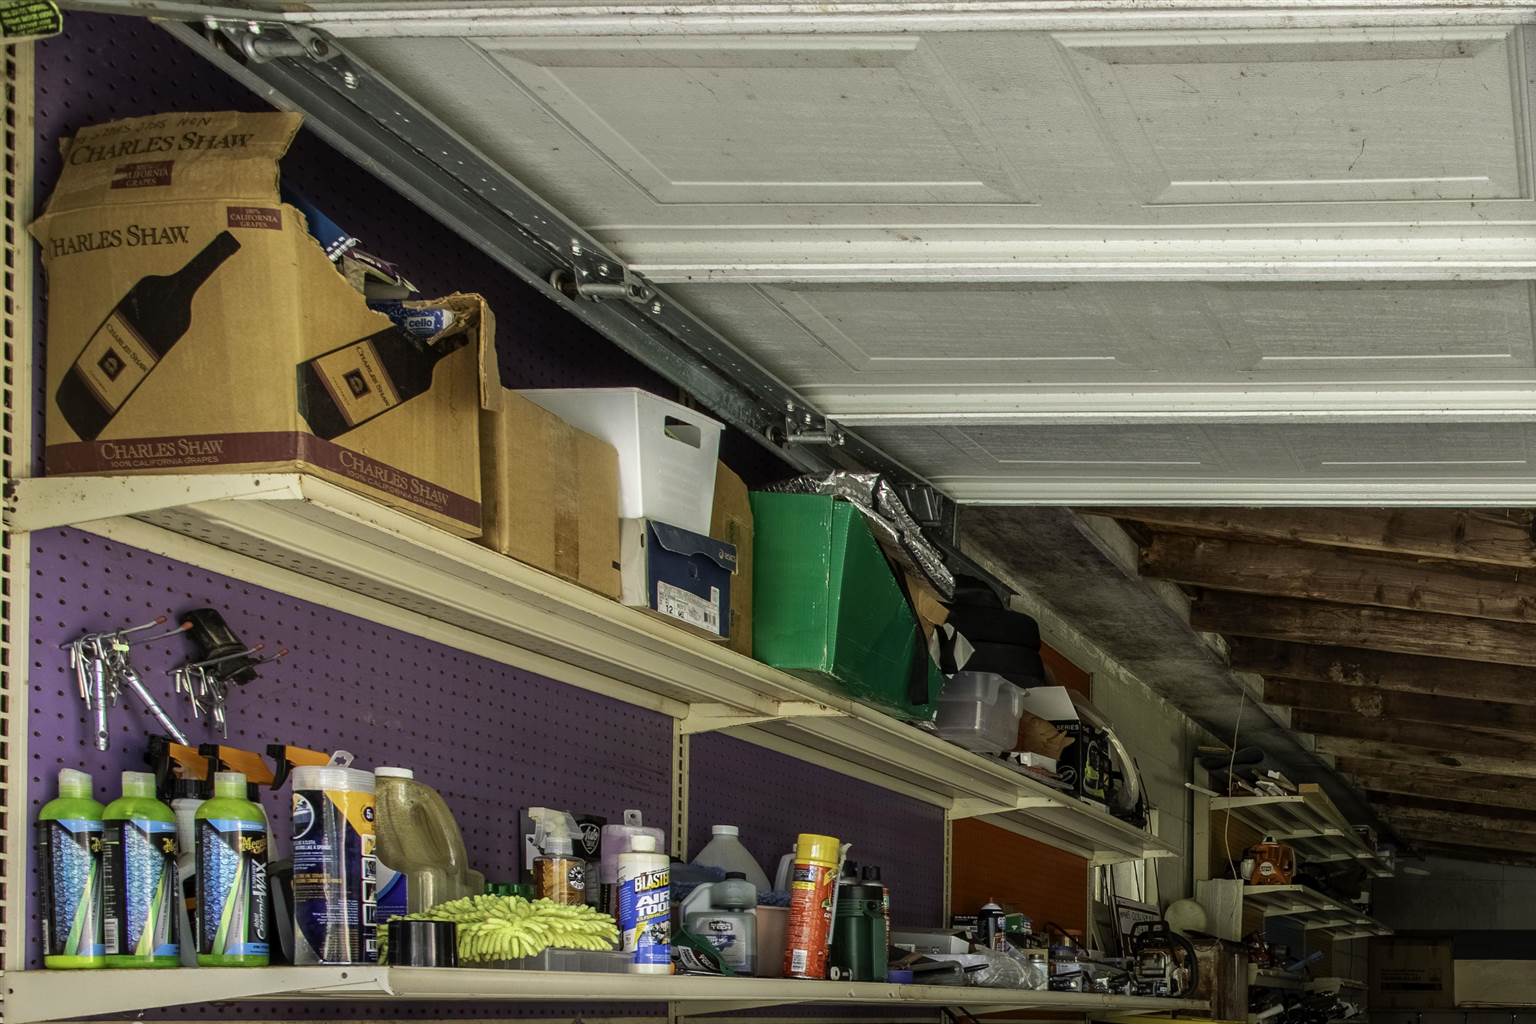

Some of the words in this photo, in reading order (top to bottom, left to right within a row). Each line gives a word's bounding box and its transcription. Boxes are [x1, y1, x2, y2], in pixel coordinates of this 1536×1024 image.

[70, 134, 175, 166] CHARLES
[177, 130, 254, 151] SHAW
[115, 168, 169, 180] ALIFORNIA
[229, 213, 279, 223] CALIFORNIA
[51, 228, 123, 258] HARLES
[408, 317, 433, 329] cello
[101, 442, 177, 460] CHARLES
[177, 438, 224, 456] SHAW
[132, 458, 183, 467] CALIFORNIA
[184, 456, 220, 464] GRAPES
[338, 449, 409, 491] CHARLES
[409, 477, 449, 506] SHAW
[366, 475, 414, 500] CALIFORNIA
[1056, 723, 1080, 731] SERIES
[252, 858, 267, 897] WAX
[634, 870, 670, 893] BLASTE
[636, 891, 670, 908] AIR
